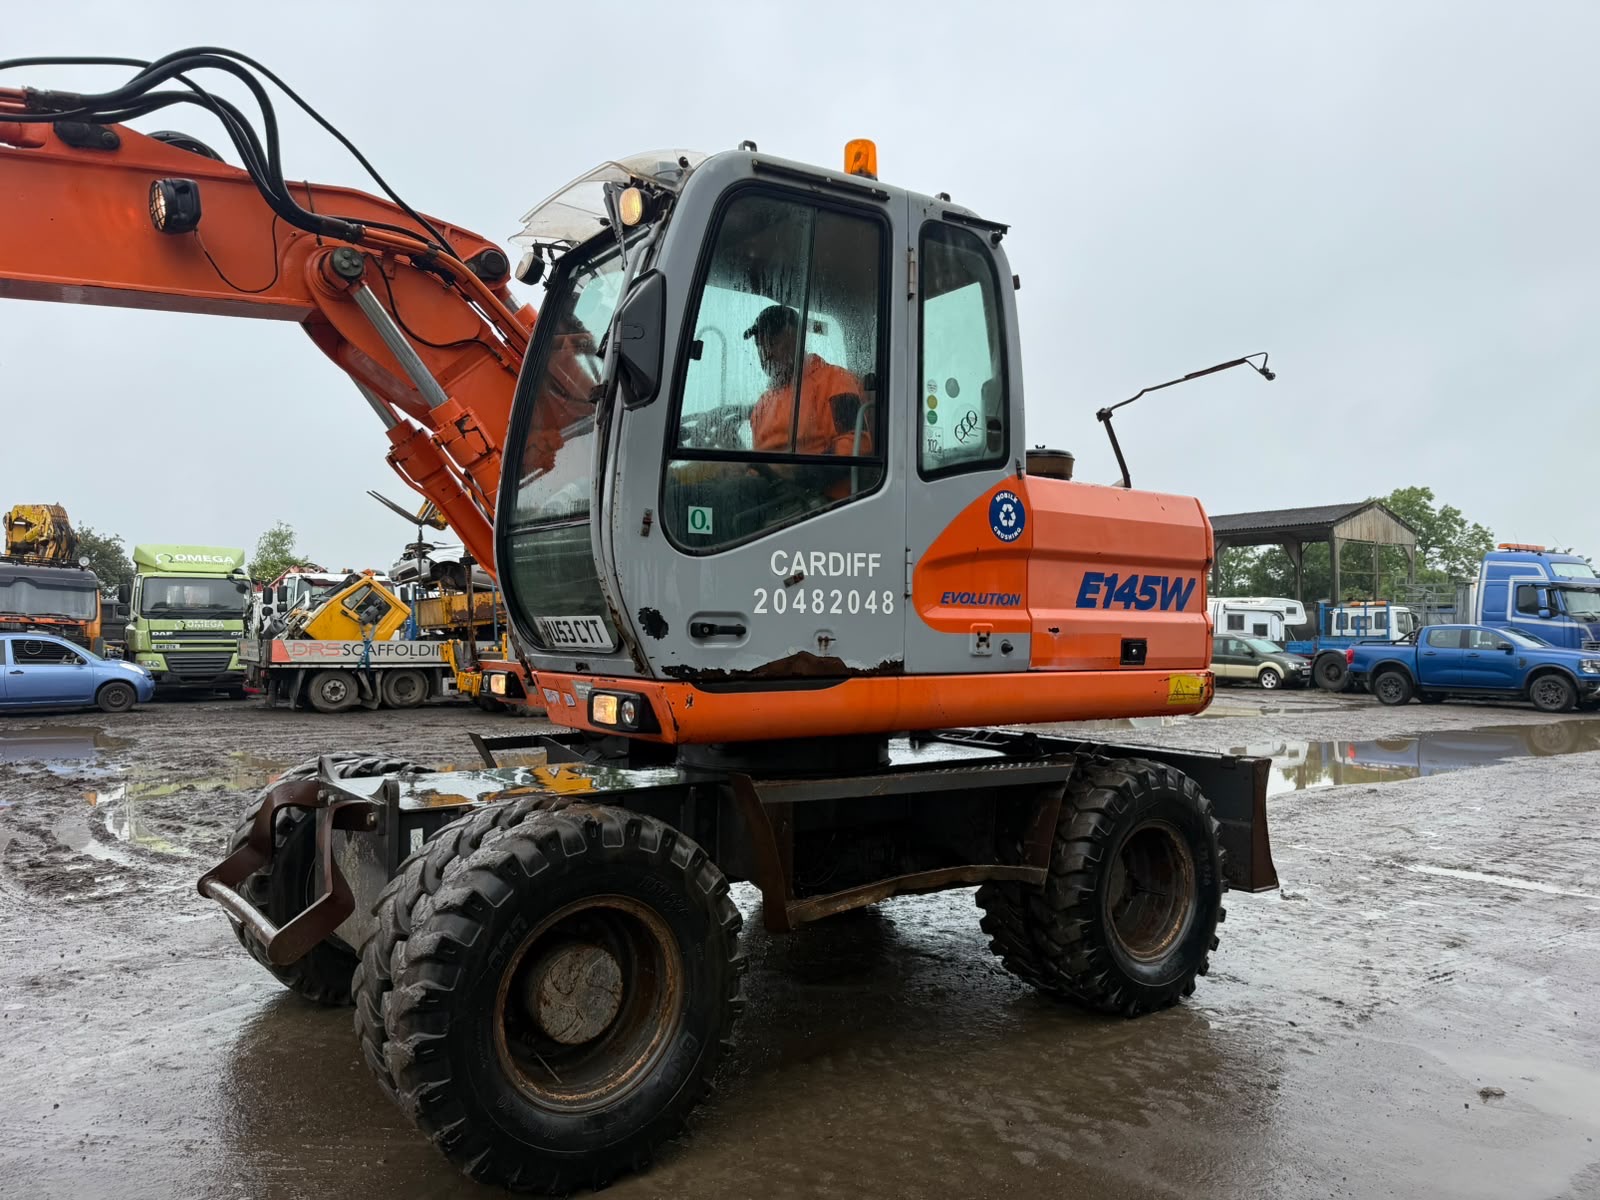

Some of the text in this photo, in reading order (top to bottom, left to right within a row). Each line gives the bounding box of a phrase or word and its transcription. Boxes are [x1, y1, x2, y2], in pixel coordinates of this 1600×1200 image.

[995, 492, 1018, 503] MOBILE
[993, 526, 1022, 540] CRUSHING
[175, 553, 235, 564] OMEGA
[770, 550, 881, 577] CARDIFF
[1076, 571, 1196, 611] E145W
[753, 588, 895, 615] 20482048
[940, 592, 1021, 606] EVOLUTION
[187, 620, 225, 628] OMEGA
[573, 620, 604, 643] CYT
[292, 643, 341, 656] DRS
